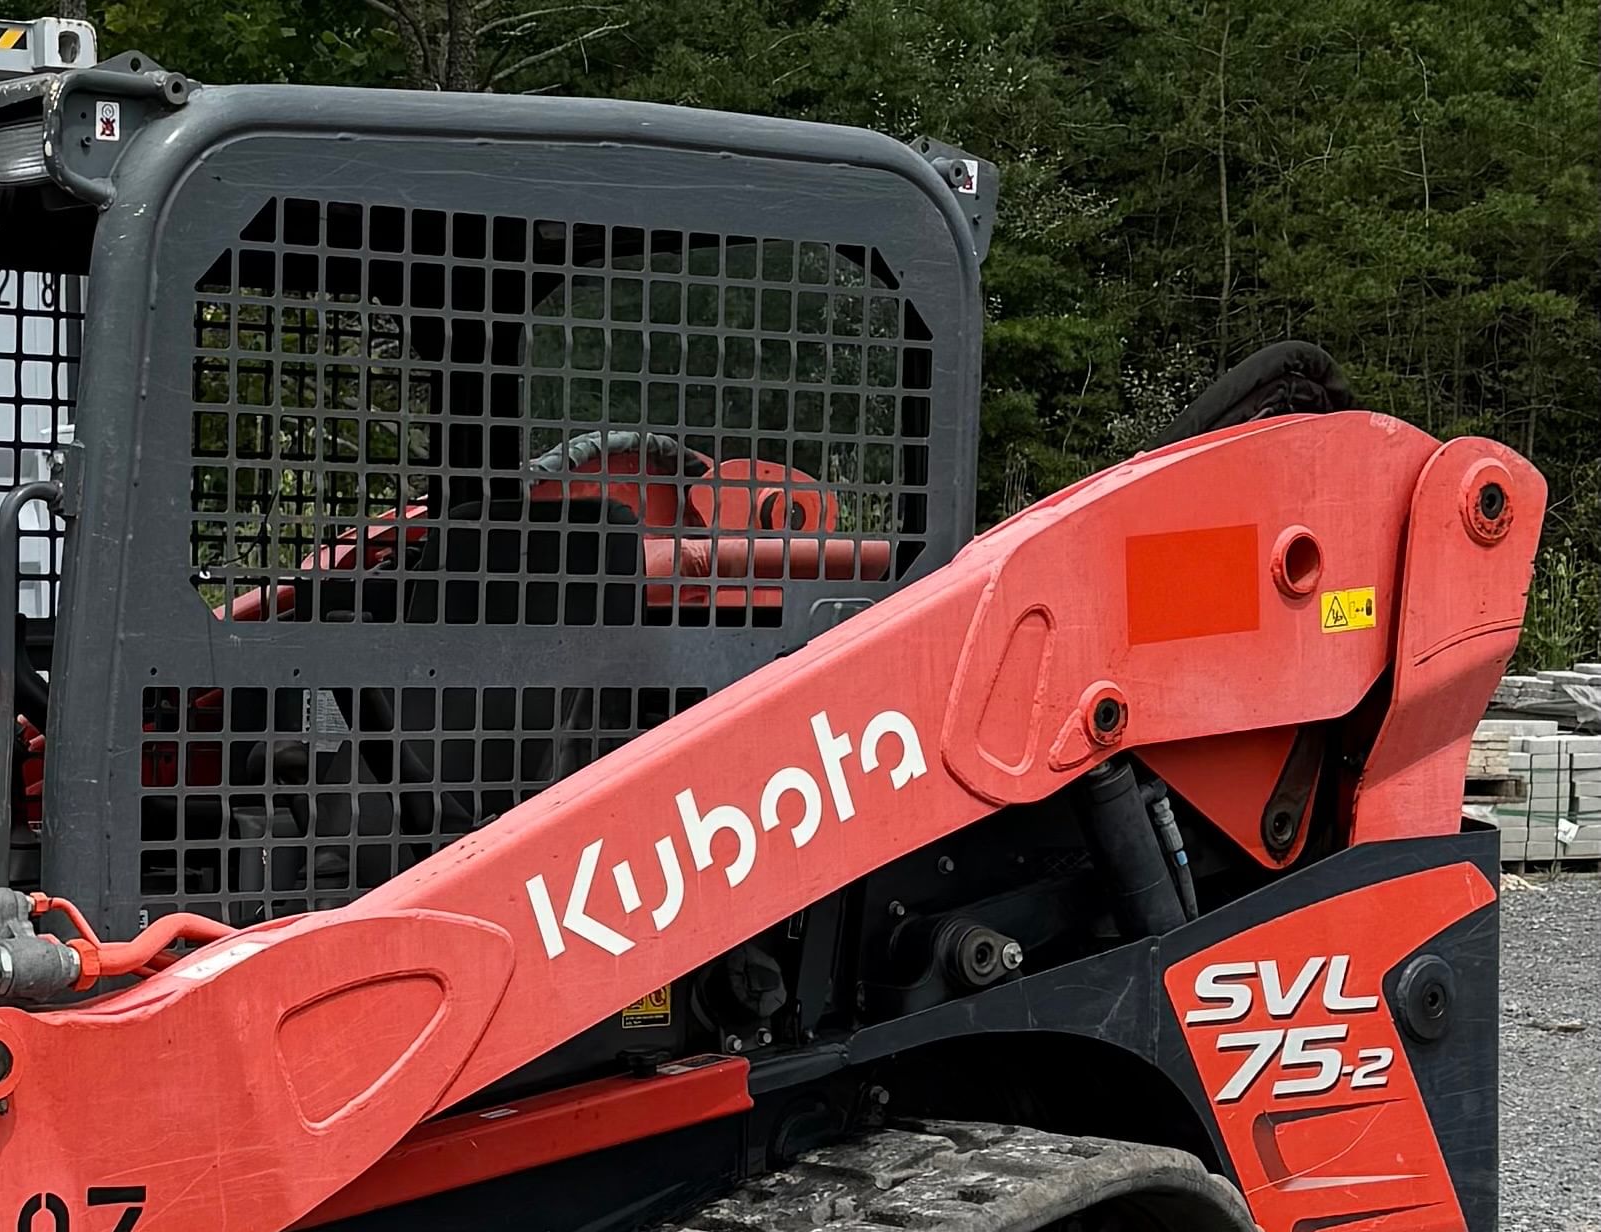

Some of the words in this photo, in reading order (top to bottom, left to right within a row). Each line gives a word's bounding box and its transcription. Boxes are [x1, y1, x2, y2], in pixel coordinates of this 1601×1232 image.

[525, 709, 928, 961] Kubota
[1184, 954, 1380, 1025] SVL
[1213, 1023, 1395, 1103] 75-2
